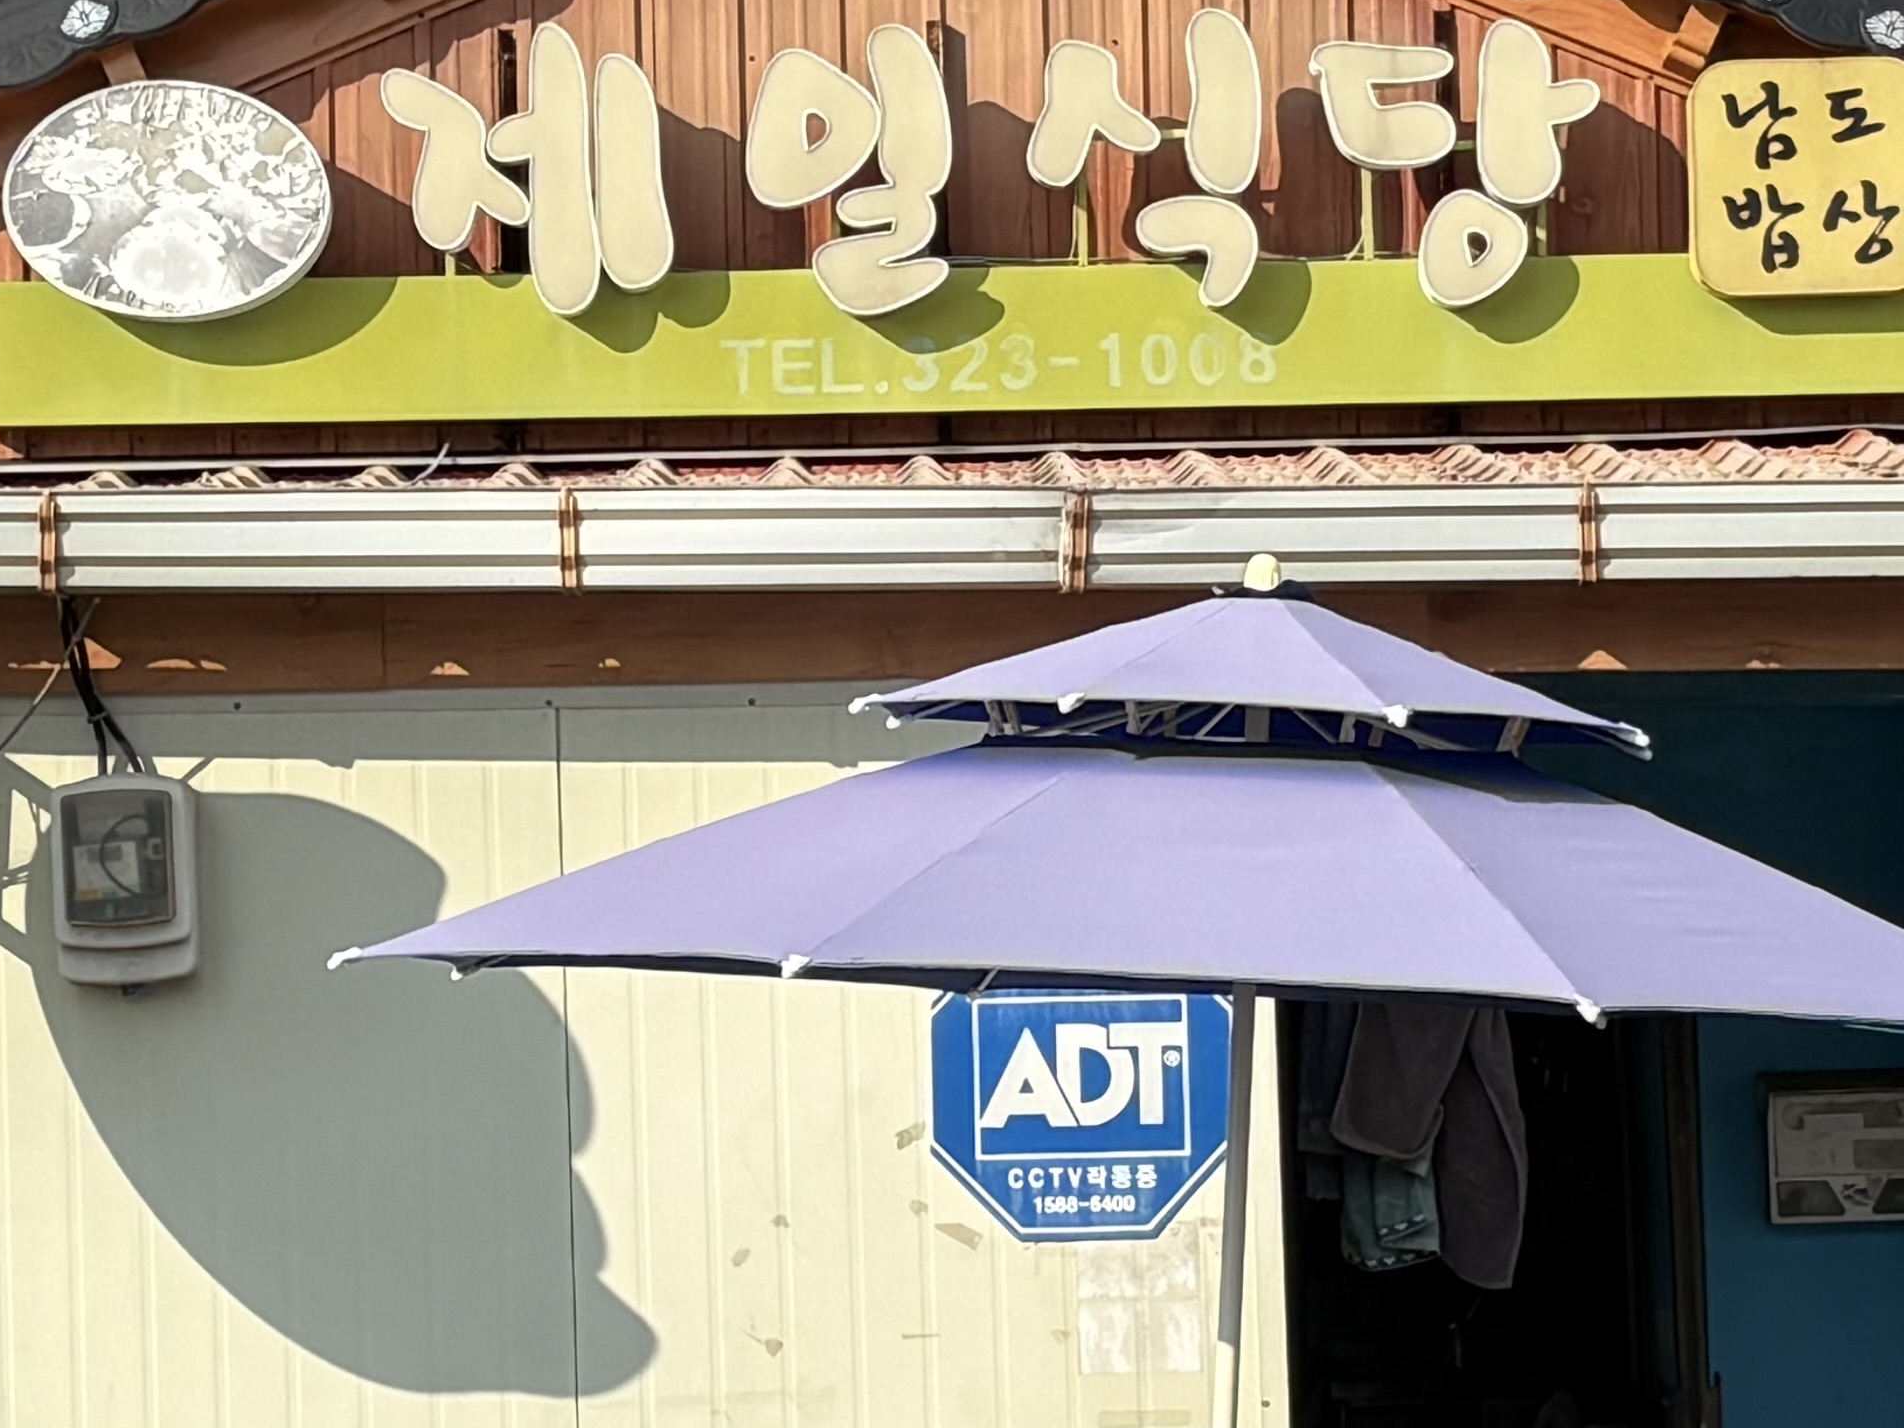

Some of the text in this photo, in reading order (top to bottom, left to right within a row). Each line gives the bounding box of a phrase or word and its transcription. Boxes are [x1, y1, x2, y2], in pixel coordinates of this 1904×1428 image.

[380, 7, 1599, 319] 제일식당
[1722, 80, 1885, 170] 남도
[1723, 180, 1899, 273] 밥상
[980, 1023, 1183, 1128] ADT
